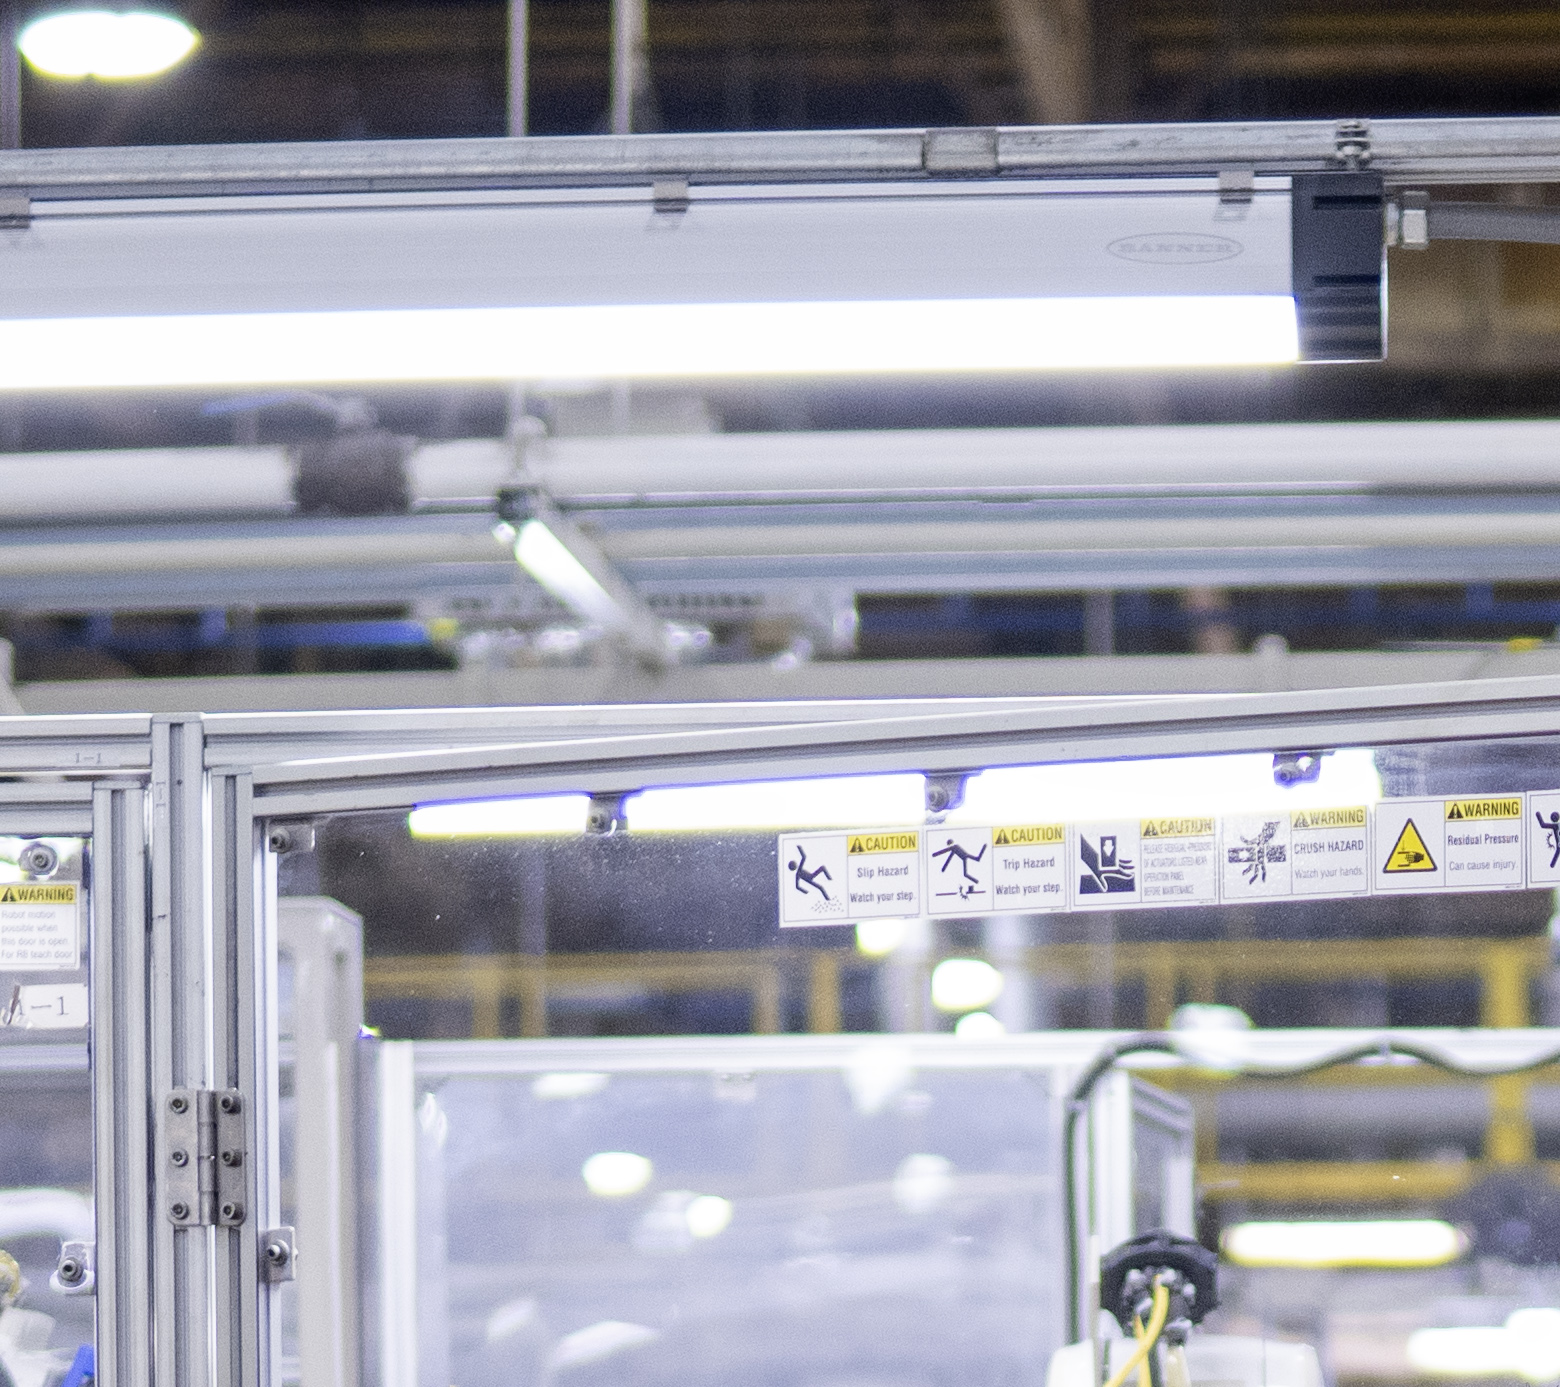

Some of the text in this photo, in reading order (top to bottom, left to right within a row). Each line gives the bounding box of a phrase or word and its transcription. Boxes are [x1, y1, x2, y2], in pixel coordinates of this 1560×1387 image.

[75, 753, 101, 763] 1-1
[1464, 801, 1519, 817] WARNING
[1309, 809, 1364, 825] WARNING
[1160, 819, 1212, 835] CAUTION
[1011, 827, 1063, 843] CAUTION
[1447, 833, 1519, 846] Residual Pressure
[866, 837, 916, 851] CAUTION
[1294, 840, 1364, 854] CRUSH HAZARD
[1003, 857, 1055, 870] Trip Hazard
[1449, 861, 1463, 871] Can
[1466, 862, 1490, 870] cause
[857, 866, 909, 878] Slip Hazard
[1294, 868, 1319, 879] Watch
[1321, 869, 1338, 879] your
[18, 887, 74, 901] WARNING
[995, 885, 1022, 895] Watch
[1023, 885, 1042, 896] your
[850, 892, 876, 903] Watch
[878, 893, 895, 904] your
